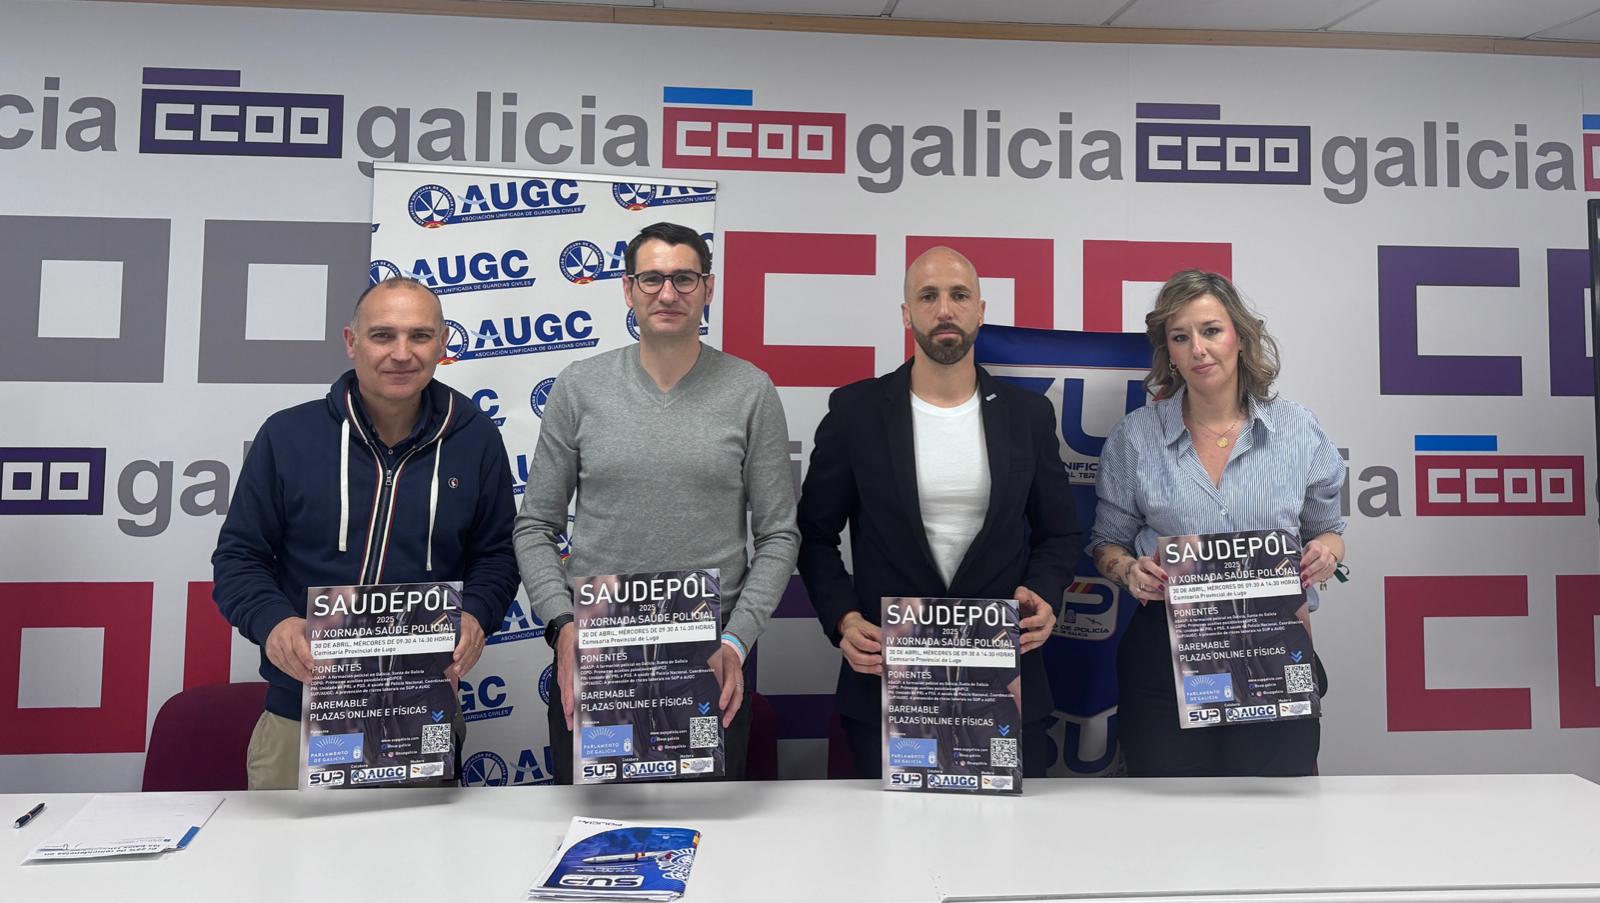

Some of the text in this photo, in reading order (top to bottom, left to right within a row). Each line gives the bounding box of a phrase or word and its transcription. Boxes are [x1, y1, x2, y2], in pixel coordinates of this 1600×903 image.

[154, 91, 650, 178] CCOO galicia
[676, 109, 1124, 193] CCOO galicia
[1148, 135, 1299, 172] CCOO
[1321, 121, 1577, 204] galicia
[461, 178, 579, 213] AUGC
[410, 249, 529, 286] AUGC
[475, 310, 593, 348] AUGC
[474, 350, 509, 358] ASOCIACIÓN
[509, 347, 538, 355] UNIFICADA
[547, 343, 574, 351] GUARDIAS
[1428, 468, 1574, 503] CCOO
[1164, 532, 1296, 563] SAUDEPÓL
[1167, 575, 1177, 584] IV
[1178, 572, 1223, 583] XORNADA
[579, 573, 715, 604] SAUDEPÓL
[313, 586, 457, 616] SAUDEPÓL
[638, 603, 655, 611] 2025
[578, 618, 587, 627] IV
[589, 615, 636, 626] XORNADA
[672, 610, 715, 621] POLICIAL
[1173, 606, 1219, 617] PONENTES
[376, 615, 394, 623] 2025
[311, 629, 321, 638] IV
[323, 627, 373, 638] XORNADA
[411, 622, 456, 633] POLICIAL
[1177, 640, 1230, 651] BAREMABLE
[580, 652, 627, 663] PONENTES
[1179, 652, 1212, 662] PLAZAS
[1212, 649, 1245, 660] ONLINE
[311, 663, 362, 674] PONENTES
[580, 688, 635, 700] BAREMABLE
[310, 698, 368, 710] BAREMABLE
[580, 701, 614, 712] PLAZAS
[615, 699, 649, 710] ONLINE
[659, 696, 693, 707] FÍSICAS
[1239, 705, 1274, 717] AUGC
[309, 711, 346, 721] PLAZAS
[346, 708, 382, 719] ONLINE
[392, 705, 427, 715] FÍSICAS
[487, 709, 509, 719] CIVILES
[366, 766, 404, 778] AUGC
[638, 761, 674, 773] AUGC
[309, 771, 343, 784] SUP
